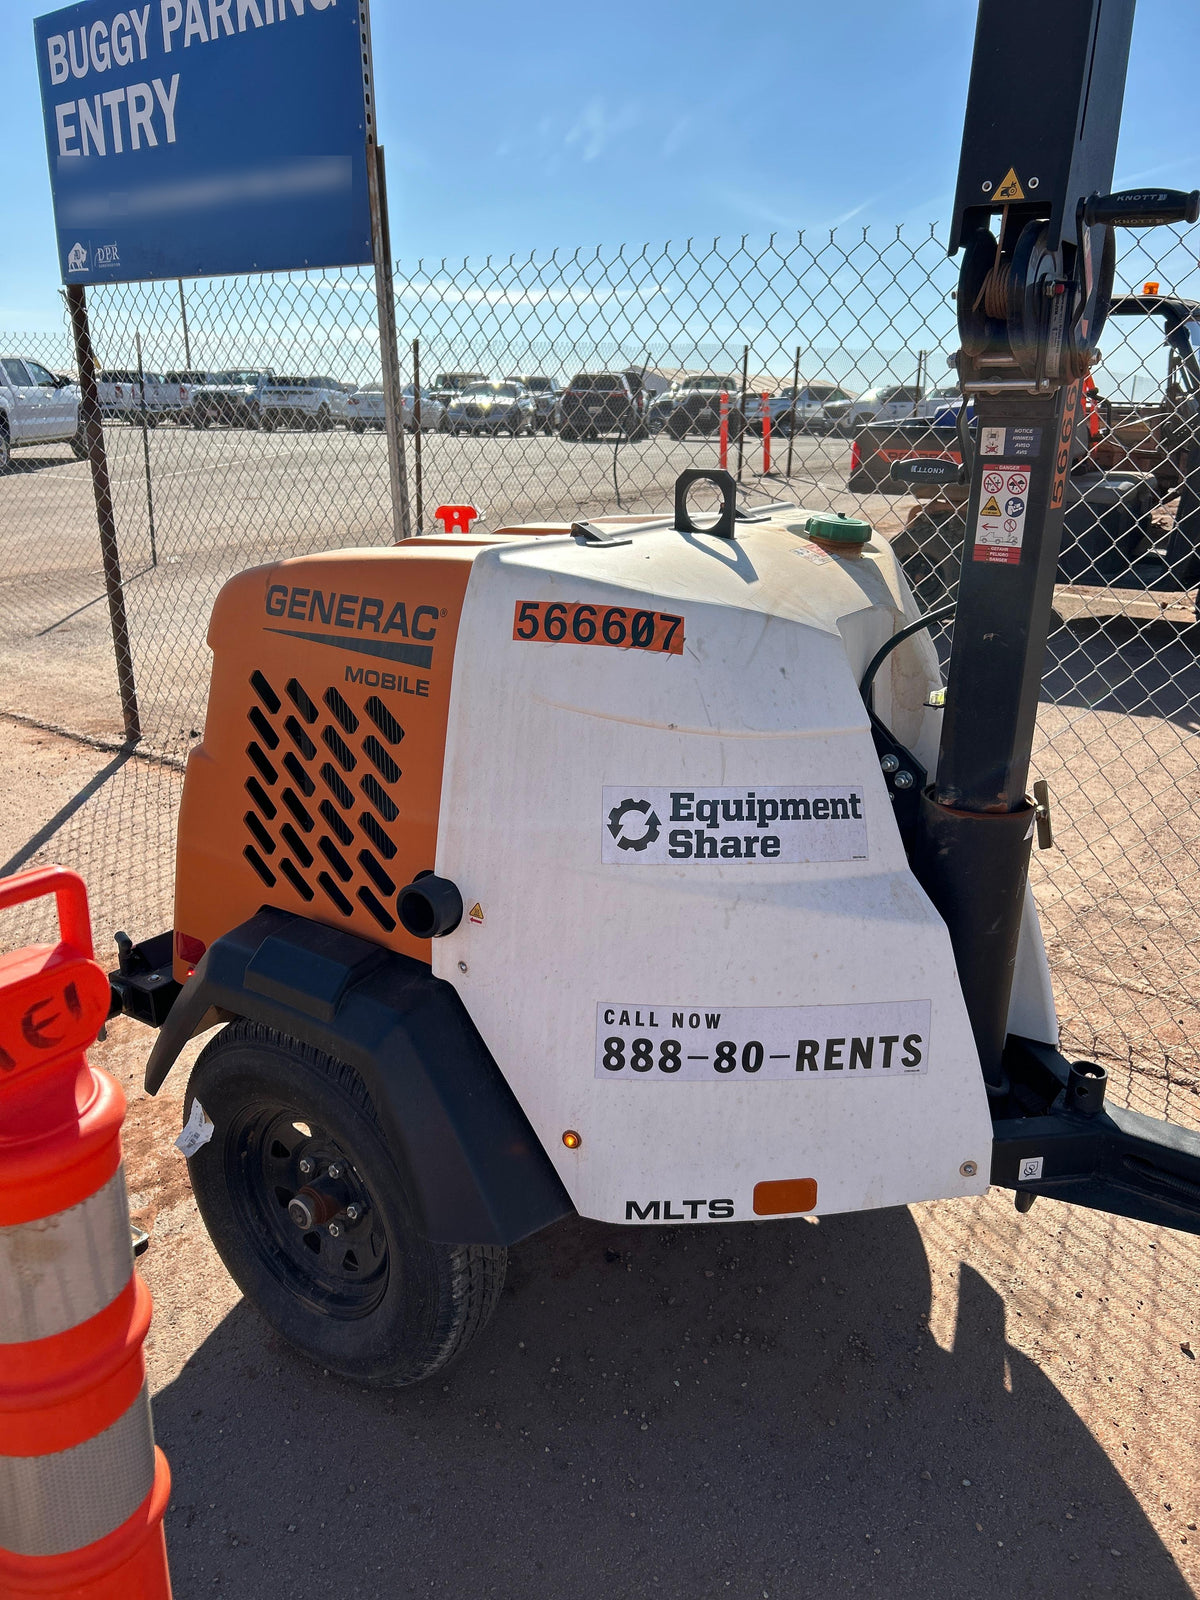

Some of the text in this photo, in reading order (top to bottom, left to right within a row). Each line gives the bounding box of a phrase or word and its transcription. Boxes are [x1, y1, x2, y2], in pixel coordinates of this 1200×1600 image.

[47, 0, 337, 85] BUGGY PARK
[55, 73, 180, 156] ENTRY
[1116, 193, 1158, 201] KNOTT
[916, 466, 945, 474] KNOTT
[517, 602, 682, 650] 566607
[344, 665, 431, 698] MOBILE
[669, 791, 863, 828] Equipment
[668, 829, 781, 859] Share
[604, 1009, 722, 1029] CALL NOW
[602, 1033, 923, 1074] 888-80-RENTS
[625, 1198, 735, 1220] MLTS
